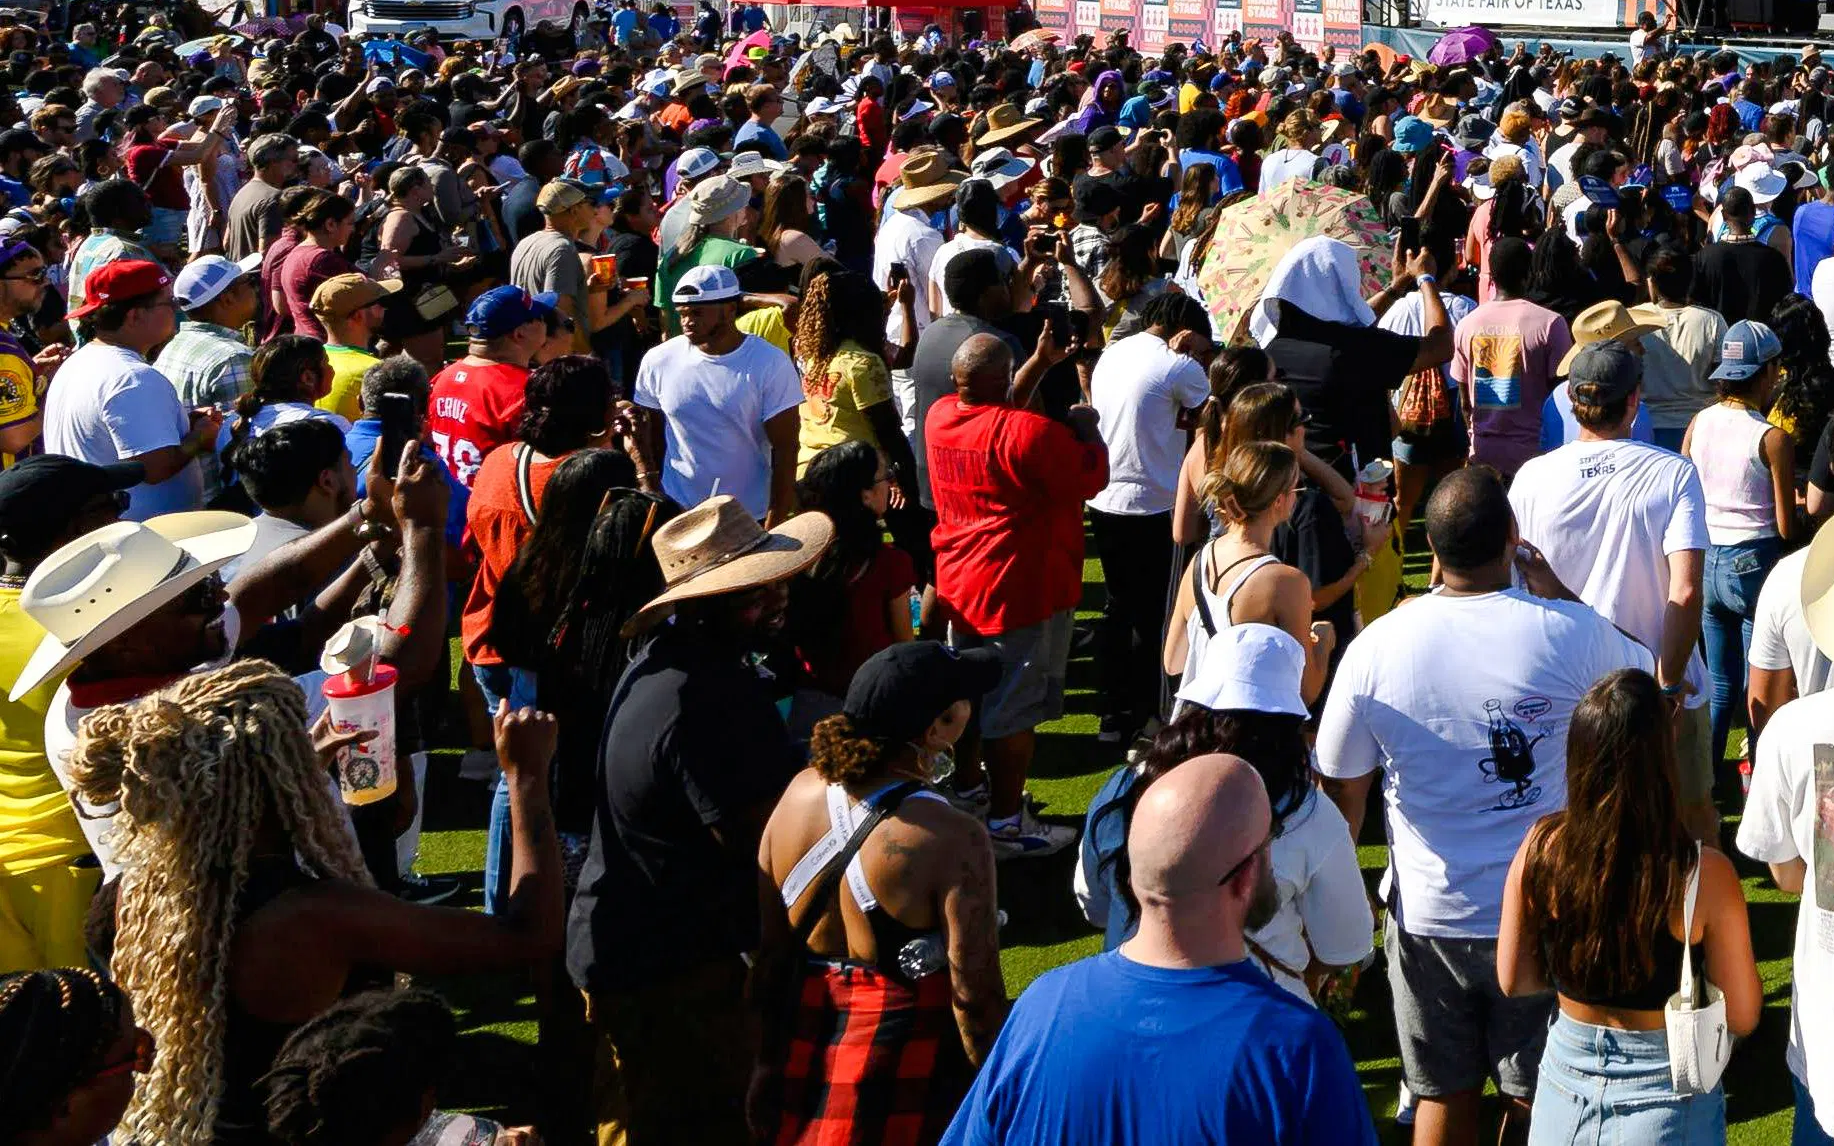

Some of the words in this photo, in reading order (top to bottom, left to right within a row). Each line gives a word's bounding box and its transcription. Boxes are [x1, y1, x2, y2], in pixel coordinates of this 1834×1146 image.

[1248, 6, 1278, 19] STAGE
[1326, 10, 1359, 23] STAGE
[1144, 31, 1165, 43] LIVE
[436, 397, 468, 423] CRUZ
[1580, 464, 1616, 478] TEXAS
